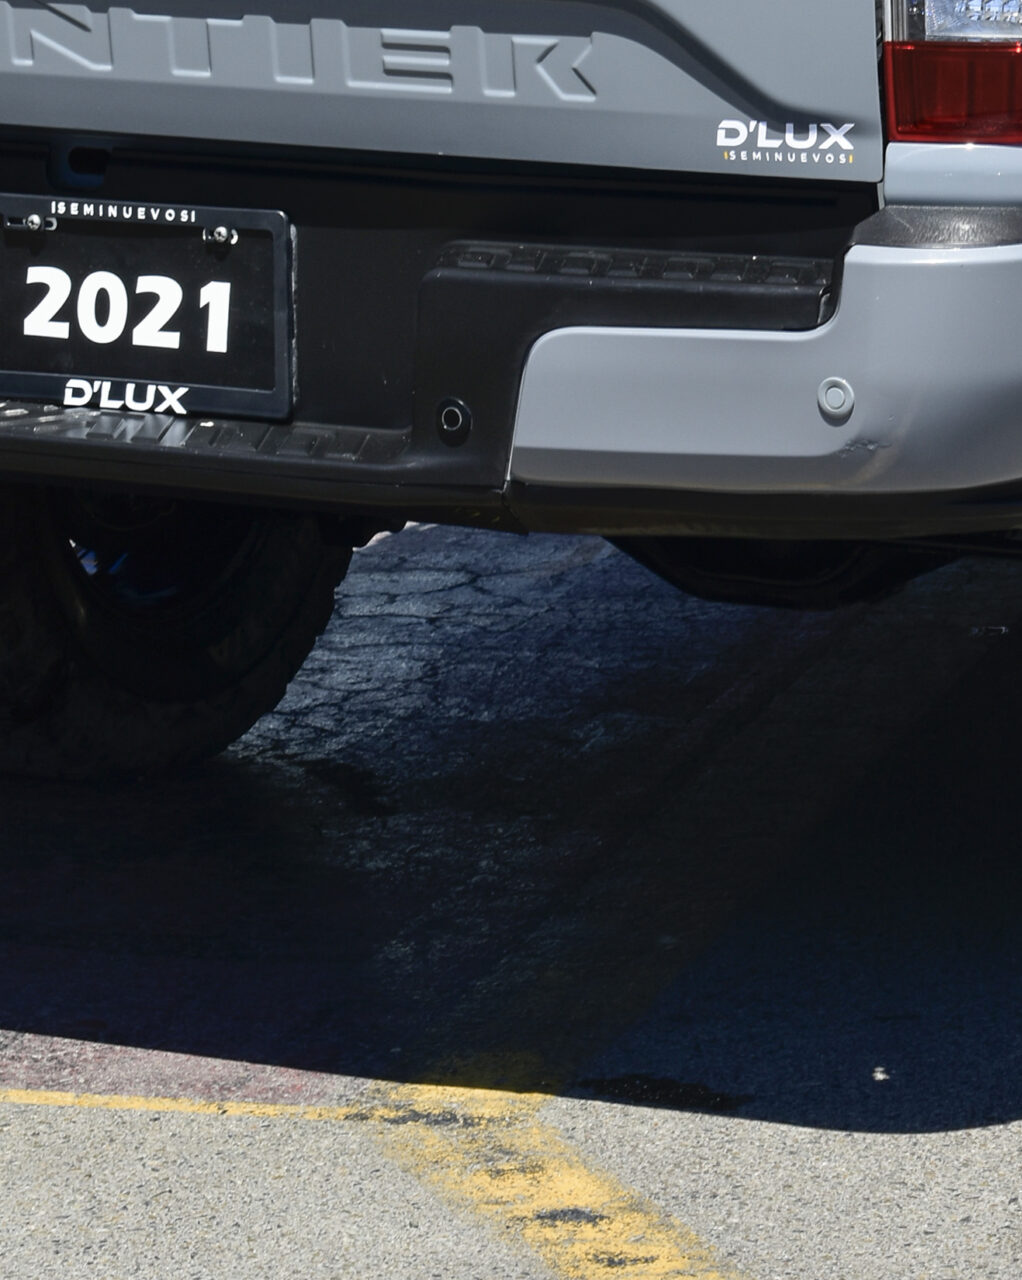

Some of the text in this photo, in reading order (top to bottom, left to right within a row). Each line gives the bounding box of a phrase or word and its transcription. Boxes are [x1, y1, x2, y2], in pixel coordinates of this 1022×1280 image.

[716, 120, 855, 150] D'LUX
[23, 266, 231, 353] 2021
[63, 379, 189, 414] D'LUX
